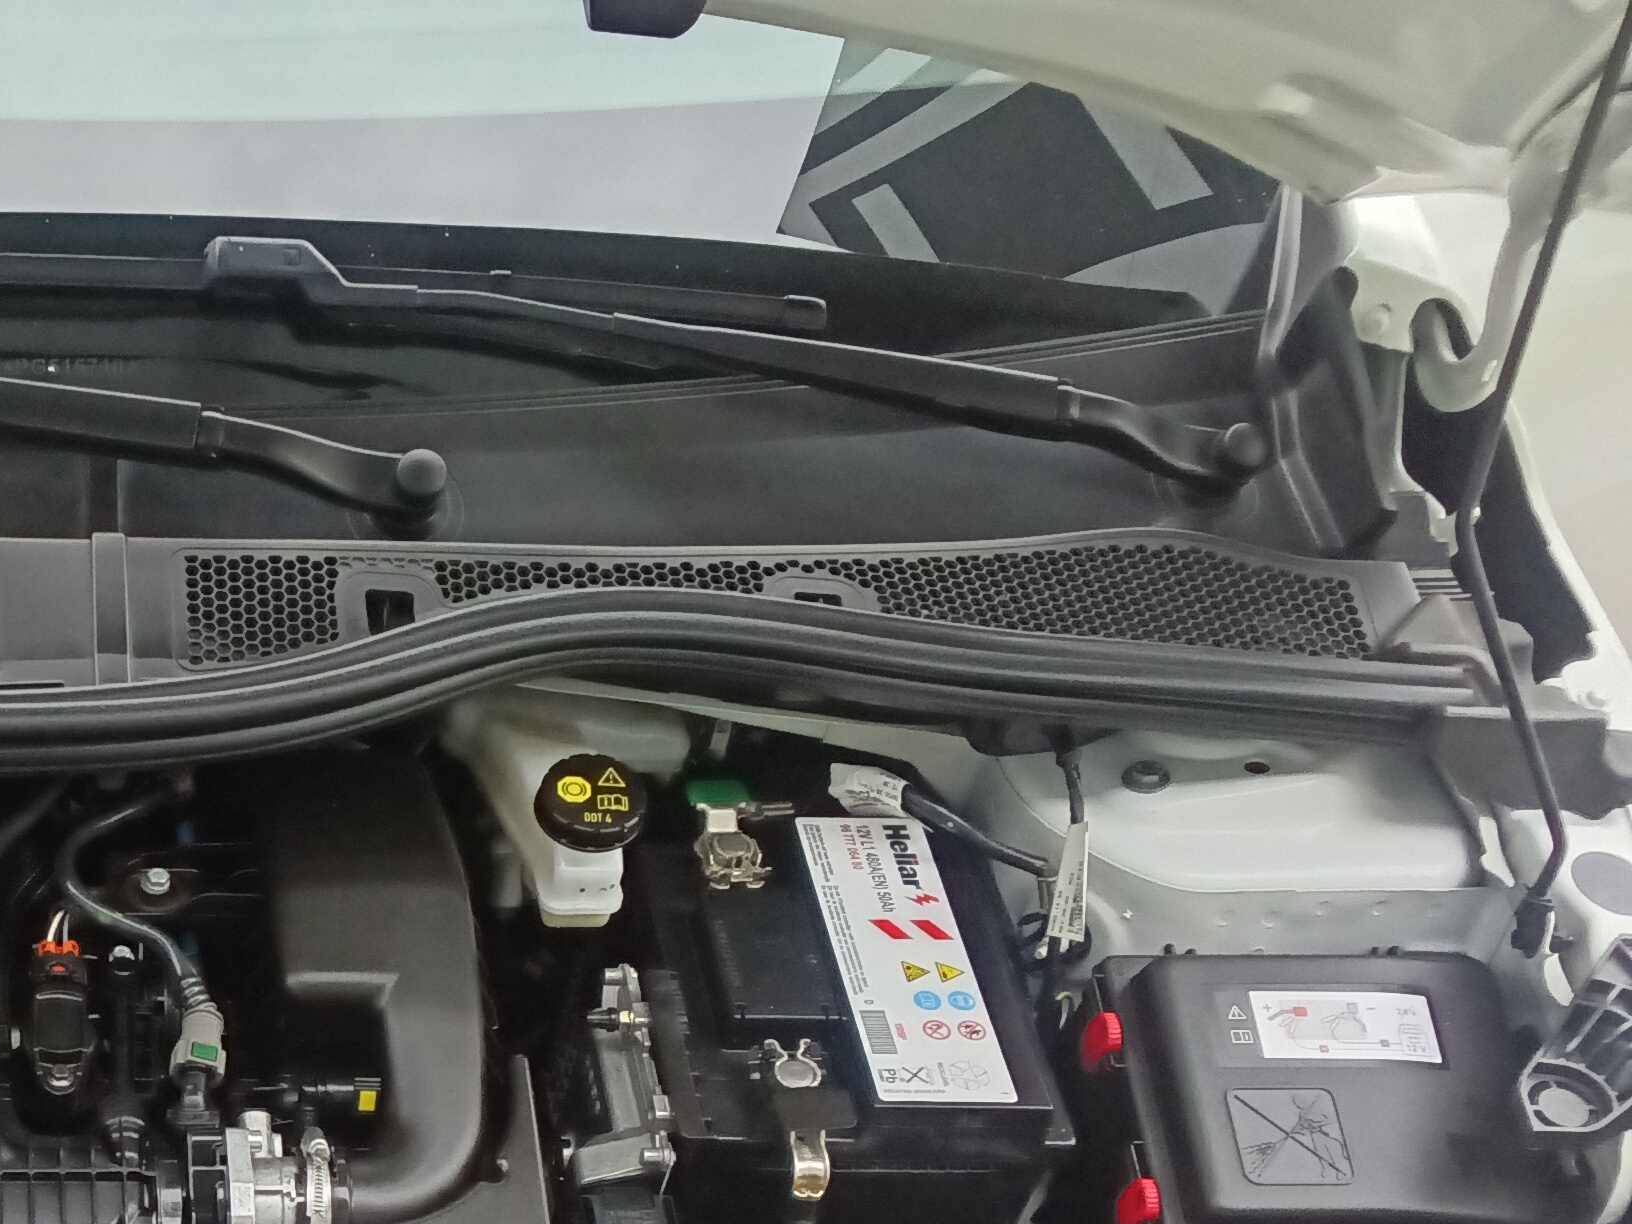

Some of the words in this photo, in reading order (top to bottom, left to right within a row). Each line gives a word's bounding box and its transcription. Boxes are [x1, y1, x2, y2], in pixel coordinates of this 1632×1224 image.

[584, 812, 603, 822] DOT
[605, 813, 612, 823] 4
[855, 824, 873, 843] 12V
[876, 891, 896, 912] 50Ah
[882, 824, 925, 890] Heliar
[883, 1068, 898, 1083] Pb
